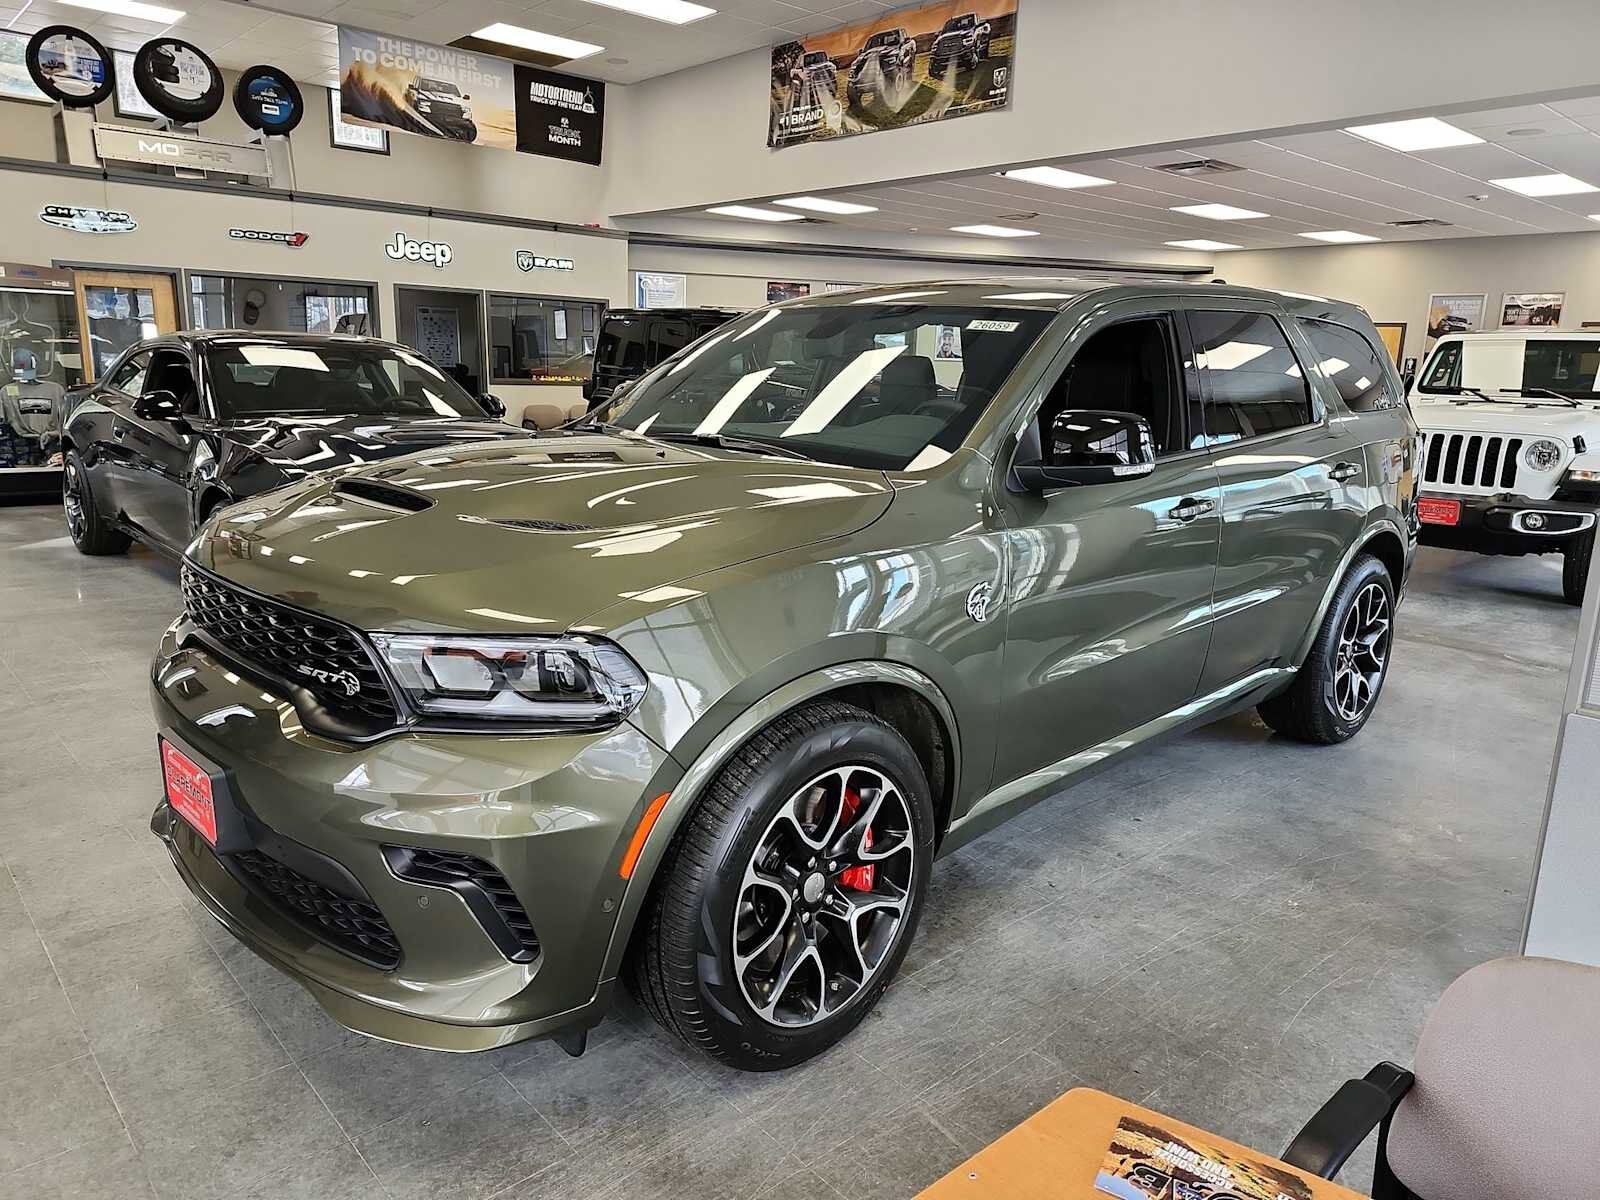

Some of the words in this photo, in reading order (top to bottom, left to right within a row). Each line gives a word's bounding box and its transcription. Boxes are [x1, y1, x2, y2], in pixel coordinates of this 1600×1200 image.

[377, 37, 412, 56] THE
[415, 43, 479, 71] POWER
[351, 47, 377, 65] TO
[380, 53, 438, 77] COME
[439, 63, 457, 79] IN
[458, 66, 503, 89] FIRST
[530, 82, 584, 105] MOTORTREND
[988, 87, 1007, 96] RAM
[530, 96, 549, 105] TRUCK
[558, 101, 568, 109] THE
[568, 103, 583, 111] YEAR
[791, 109, 824, 125] BRAND
[548, 124, 582, 139] TRUCK
[548, 134, 582, 147] MONTH
[230, 229, 297, 242] DODGE
[385, 233, 452, 267] Jeep
[535, 257, 574, 270] RAM
[296, 664, 346, 684] SRT
[1200, 1157, 1233, 1180] AND
